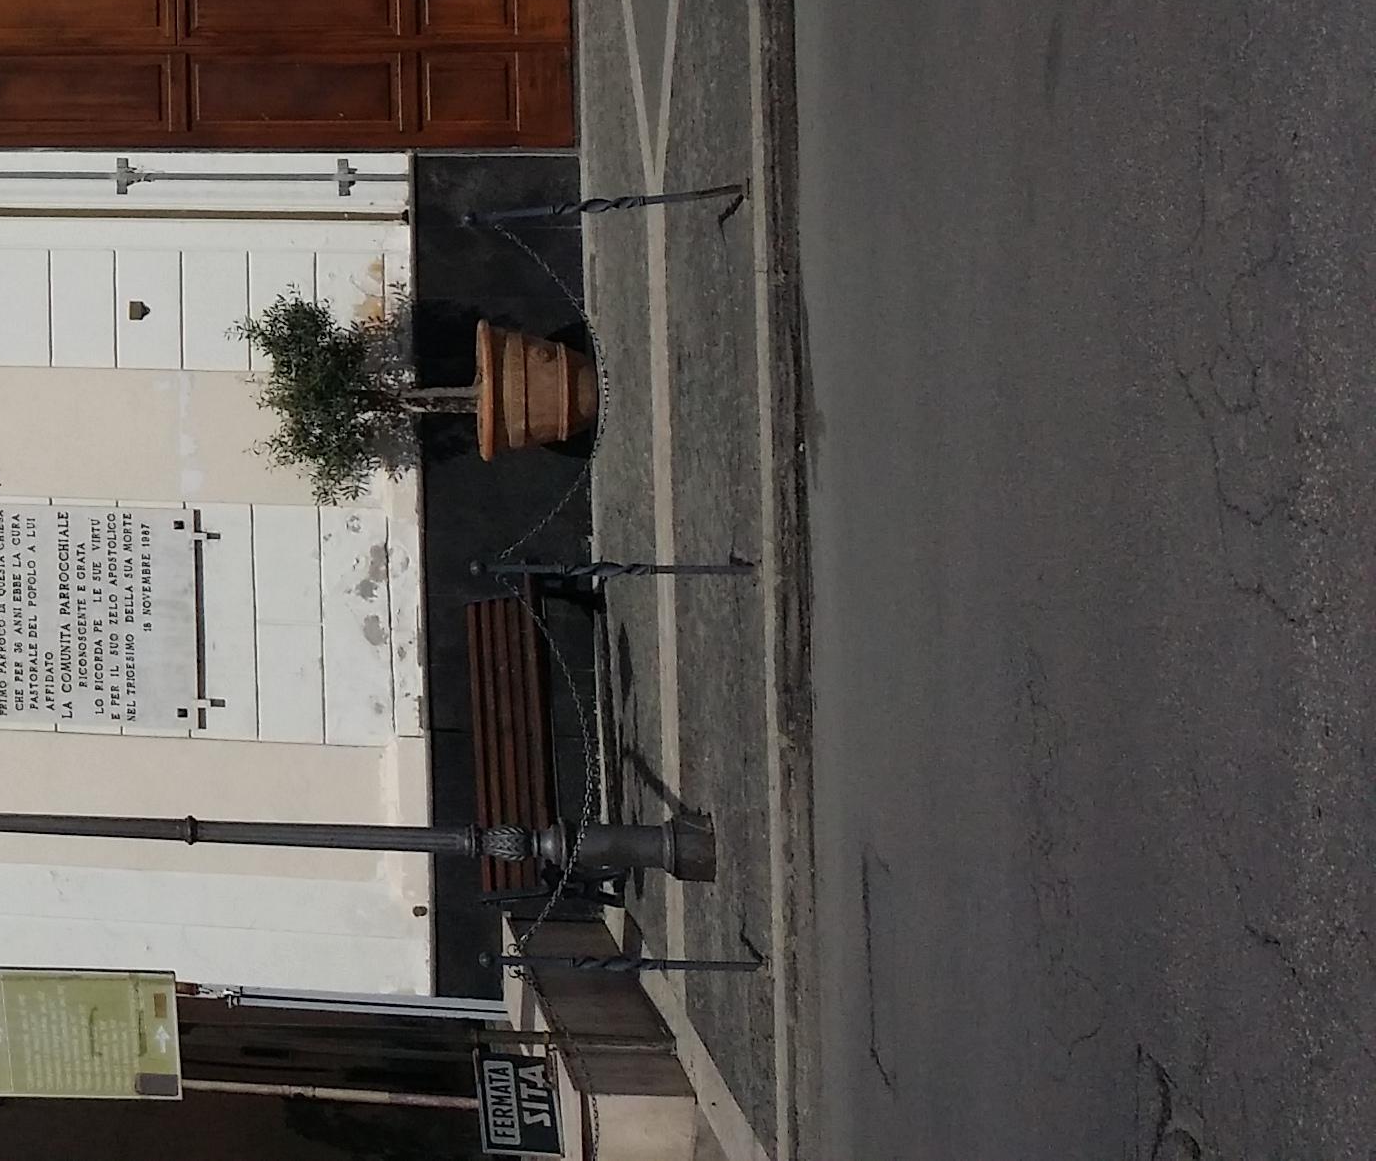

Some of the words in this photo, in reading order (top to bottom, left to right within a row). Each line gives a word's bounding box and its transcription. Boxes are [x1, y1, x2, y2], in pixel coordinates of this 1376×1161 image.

[12, 513, 20, 545] CURA
[27, 518, 36, 537] LUI
[123, 513, 132, 551] MORTE
[141, 523, 150, 547] 1987
[12, 553, 22, 567] LA
[58, 511, 70, 615] PARROCCHIALE
[76, 543, 86, 579] GRATA
[107, 513, 118, 586] APOSTOLICO
[92, 561, 102, 581] SUE
[124, 557, 132, 578] SUA
[12, 573, 22, 602] EBBE
[28, 561, 36, 607] POPOLO
[93, 589, 102, 603] LE
[142, 553, 152, 615] NOVEMBRE
[108, 594, 118, 625] ZELO
[124, 585, 134, 623] DELLA
[13, 607, 23, 634] ANNI
[28, 615, 38, 638] DEL
[14, 641, 23, 653] 36
[78, 599, 88, 687] RICONOSCENTE
[110, 633, 118, 655] SUO
[14, 661, 24, 682] PER
[60, 623, 72, 693] COMUNITA
[94, 639, 104, 691] RICORDA
[110, 665, 119, 677] IL
[125, 633, 136, 695] TRIGESIMO
[28, 643, 38, 709] PASTORALE
[44, 651, 54, 711] AFFIDATO
[14, 689, 24, 711] CHE
[62, 701, 72, 719] LA
[95, 699, 104, 715] LO
[110, 685, 120, 706] PER
[126, 701, 136, 721] NEL
[488, 1067, 516, 1139] FERMATA
[518, 1063, 552, 1127] SITA
